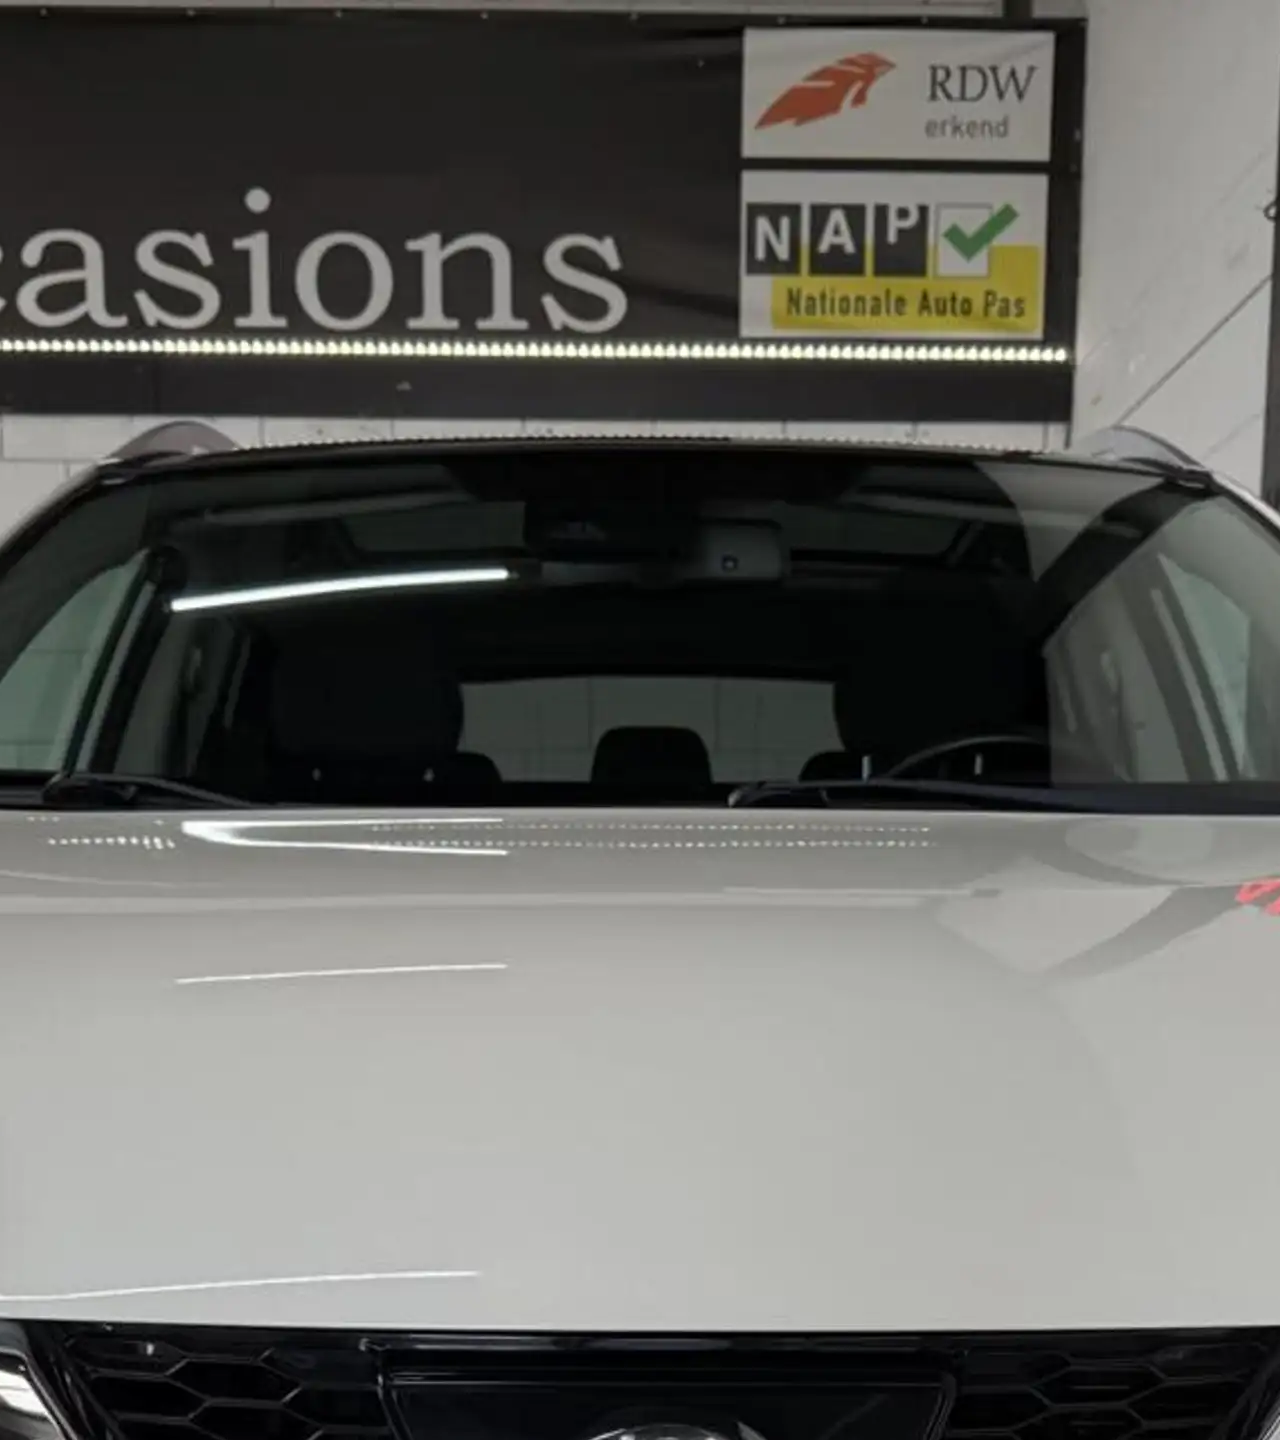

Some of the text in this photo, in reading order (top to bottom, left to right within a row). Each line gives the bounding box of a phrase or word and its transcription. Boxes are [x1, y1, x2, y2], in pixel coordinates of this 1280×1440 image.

[927, 64, 1038, 103] RDW
[924, 115, 1010, 139] erkend
[786, 287, 1026, 318] Nationale Auto Pas
